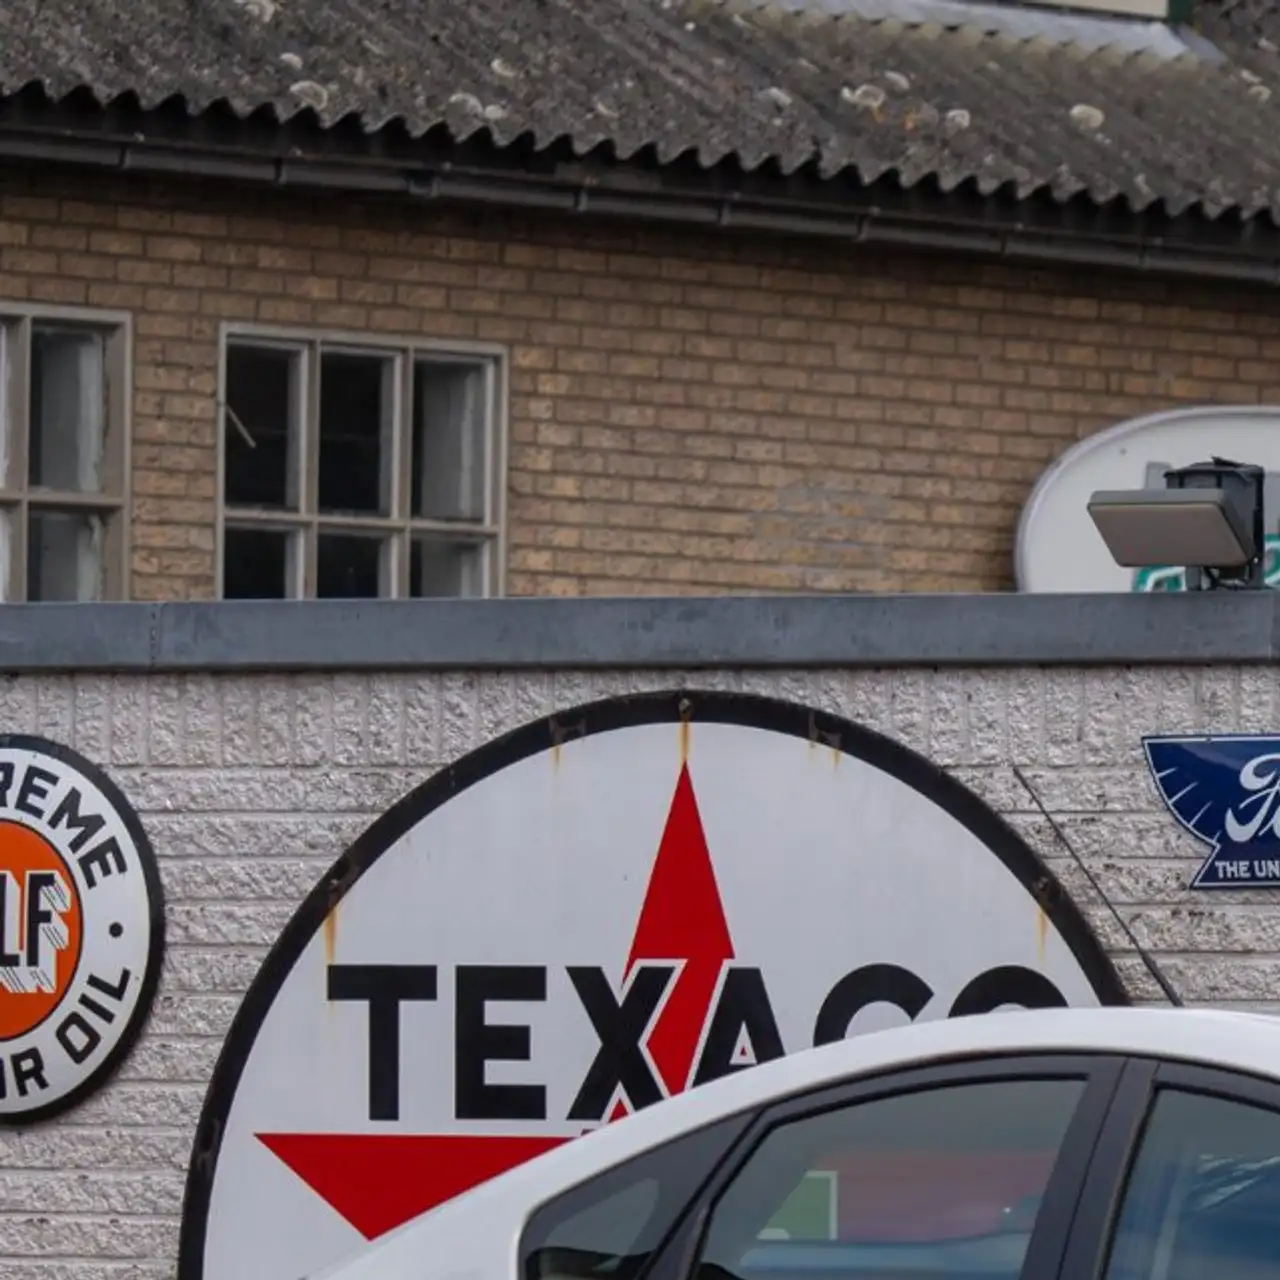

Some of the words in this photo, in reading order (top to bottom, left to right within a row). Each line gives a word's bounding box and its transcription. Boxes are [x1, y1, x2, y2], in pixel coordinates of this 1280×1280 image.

[1214, 860, 1250, 879] THE
[56, 967, 131, 1065] OIL
[326, 962, 1069, 1122] TEXA
